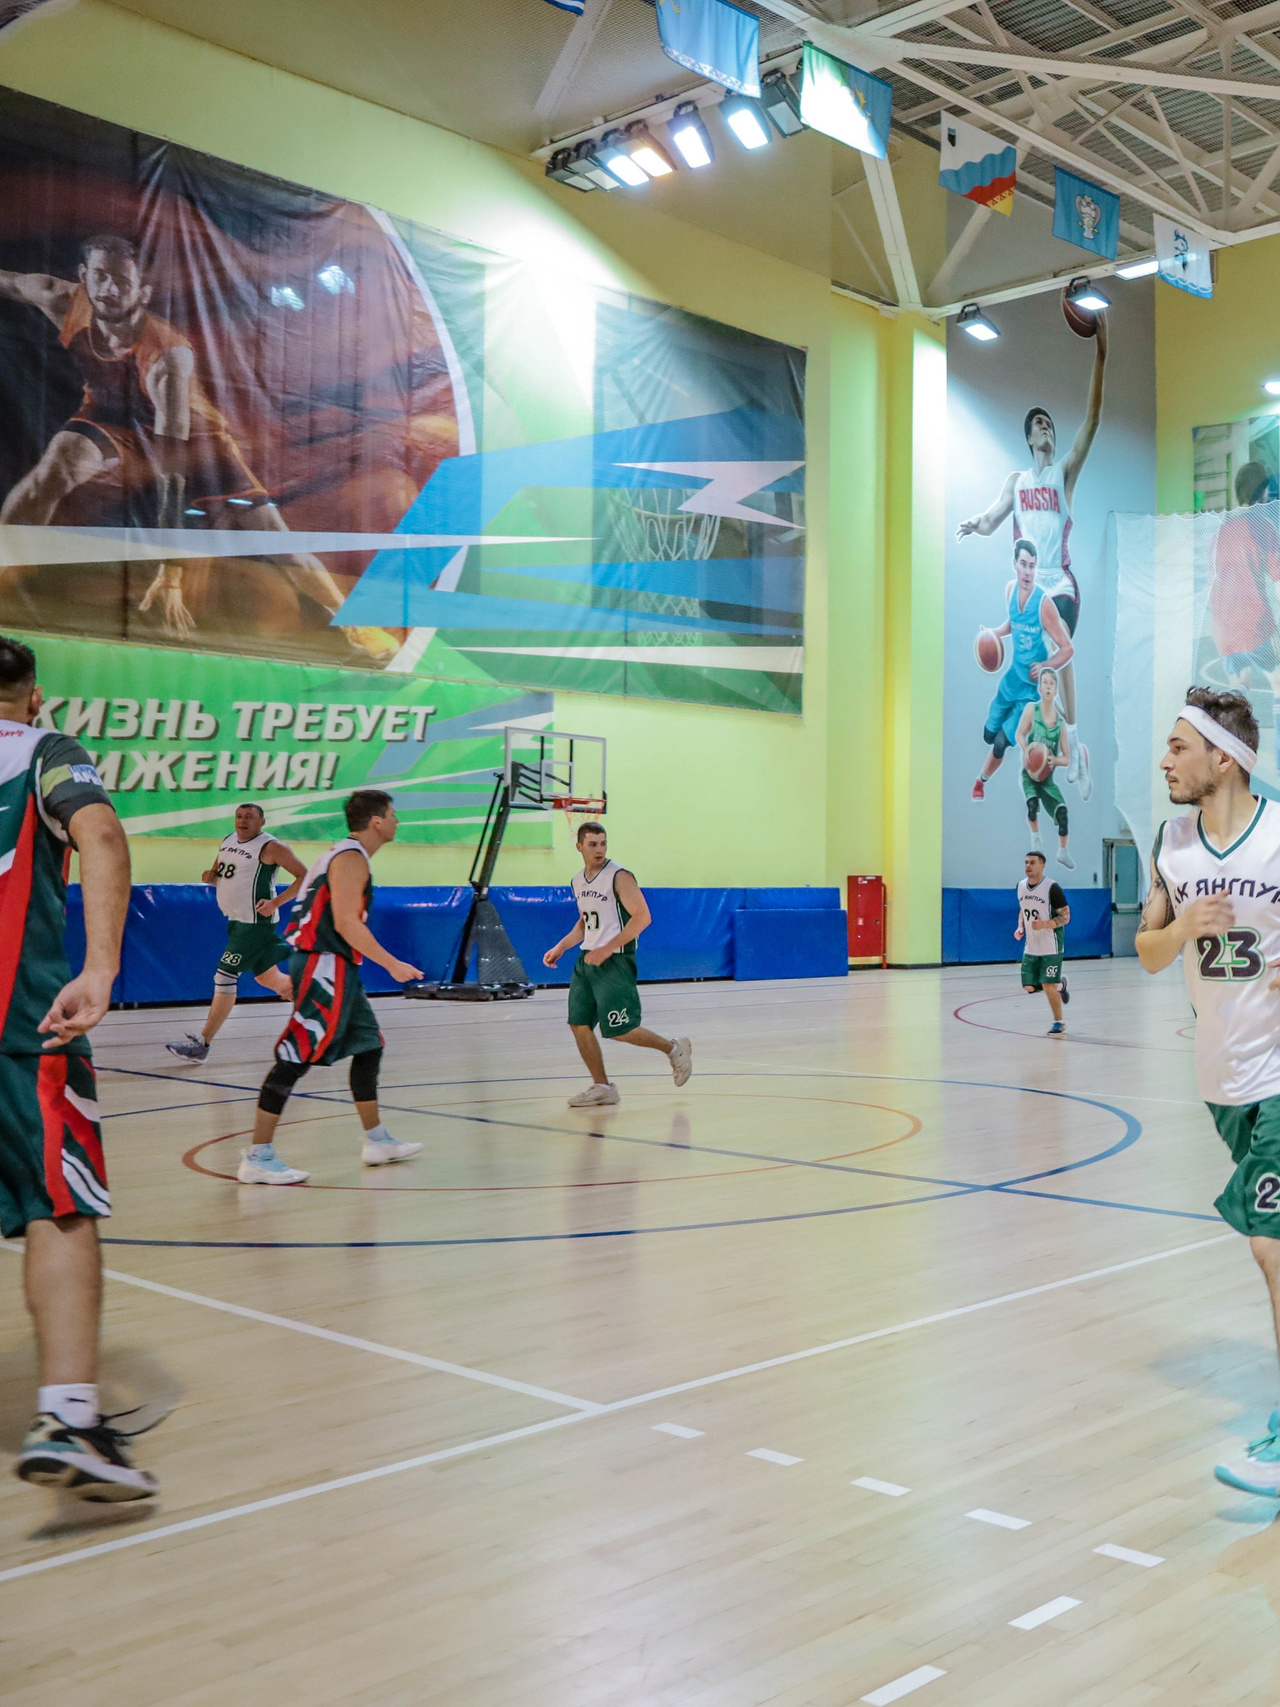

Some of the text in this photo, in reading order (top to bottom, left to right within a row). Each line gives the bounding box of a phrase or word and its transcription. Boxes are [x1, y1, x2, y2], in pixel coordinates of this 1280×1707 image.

[1019, 486, 1060, 513] RUSSIA
[232, 701, 436, 742] ТРЕБУЕТ
[89, 750, 339, 792] ИЖЕНИЯ!
[217, 861, 235, 879] 28
[220, 951, 242, 966] 28
[1194, 926, 1266, 982] 23
[607, 1007, 630, 1027] 24
